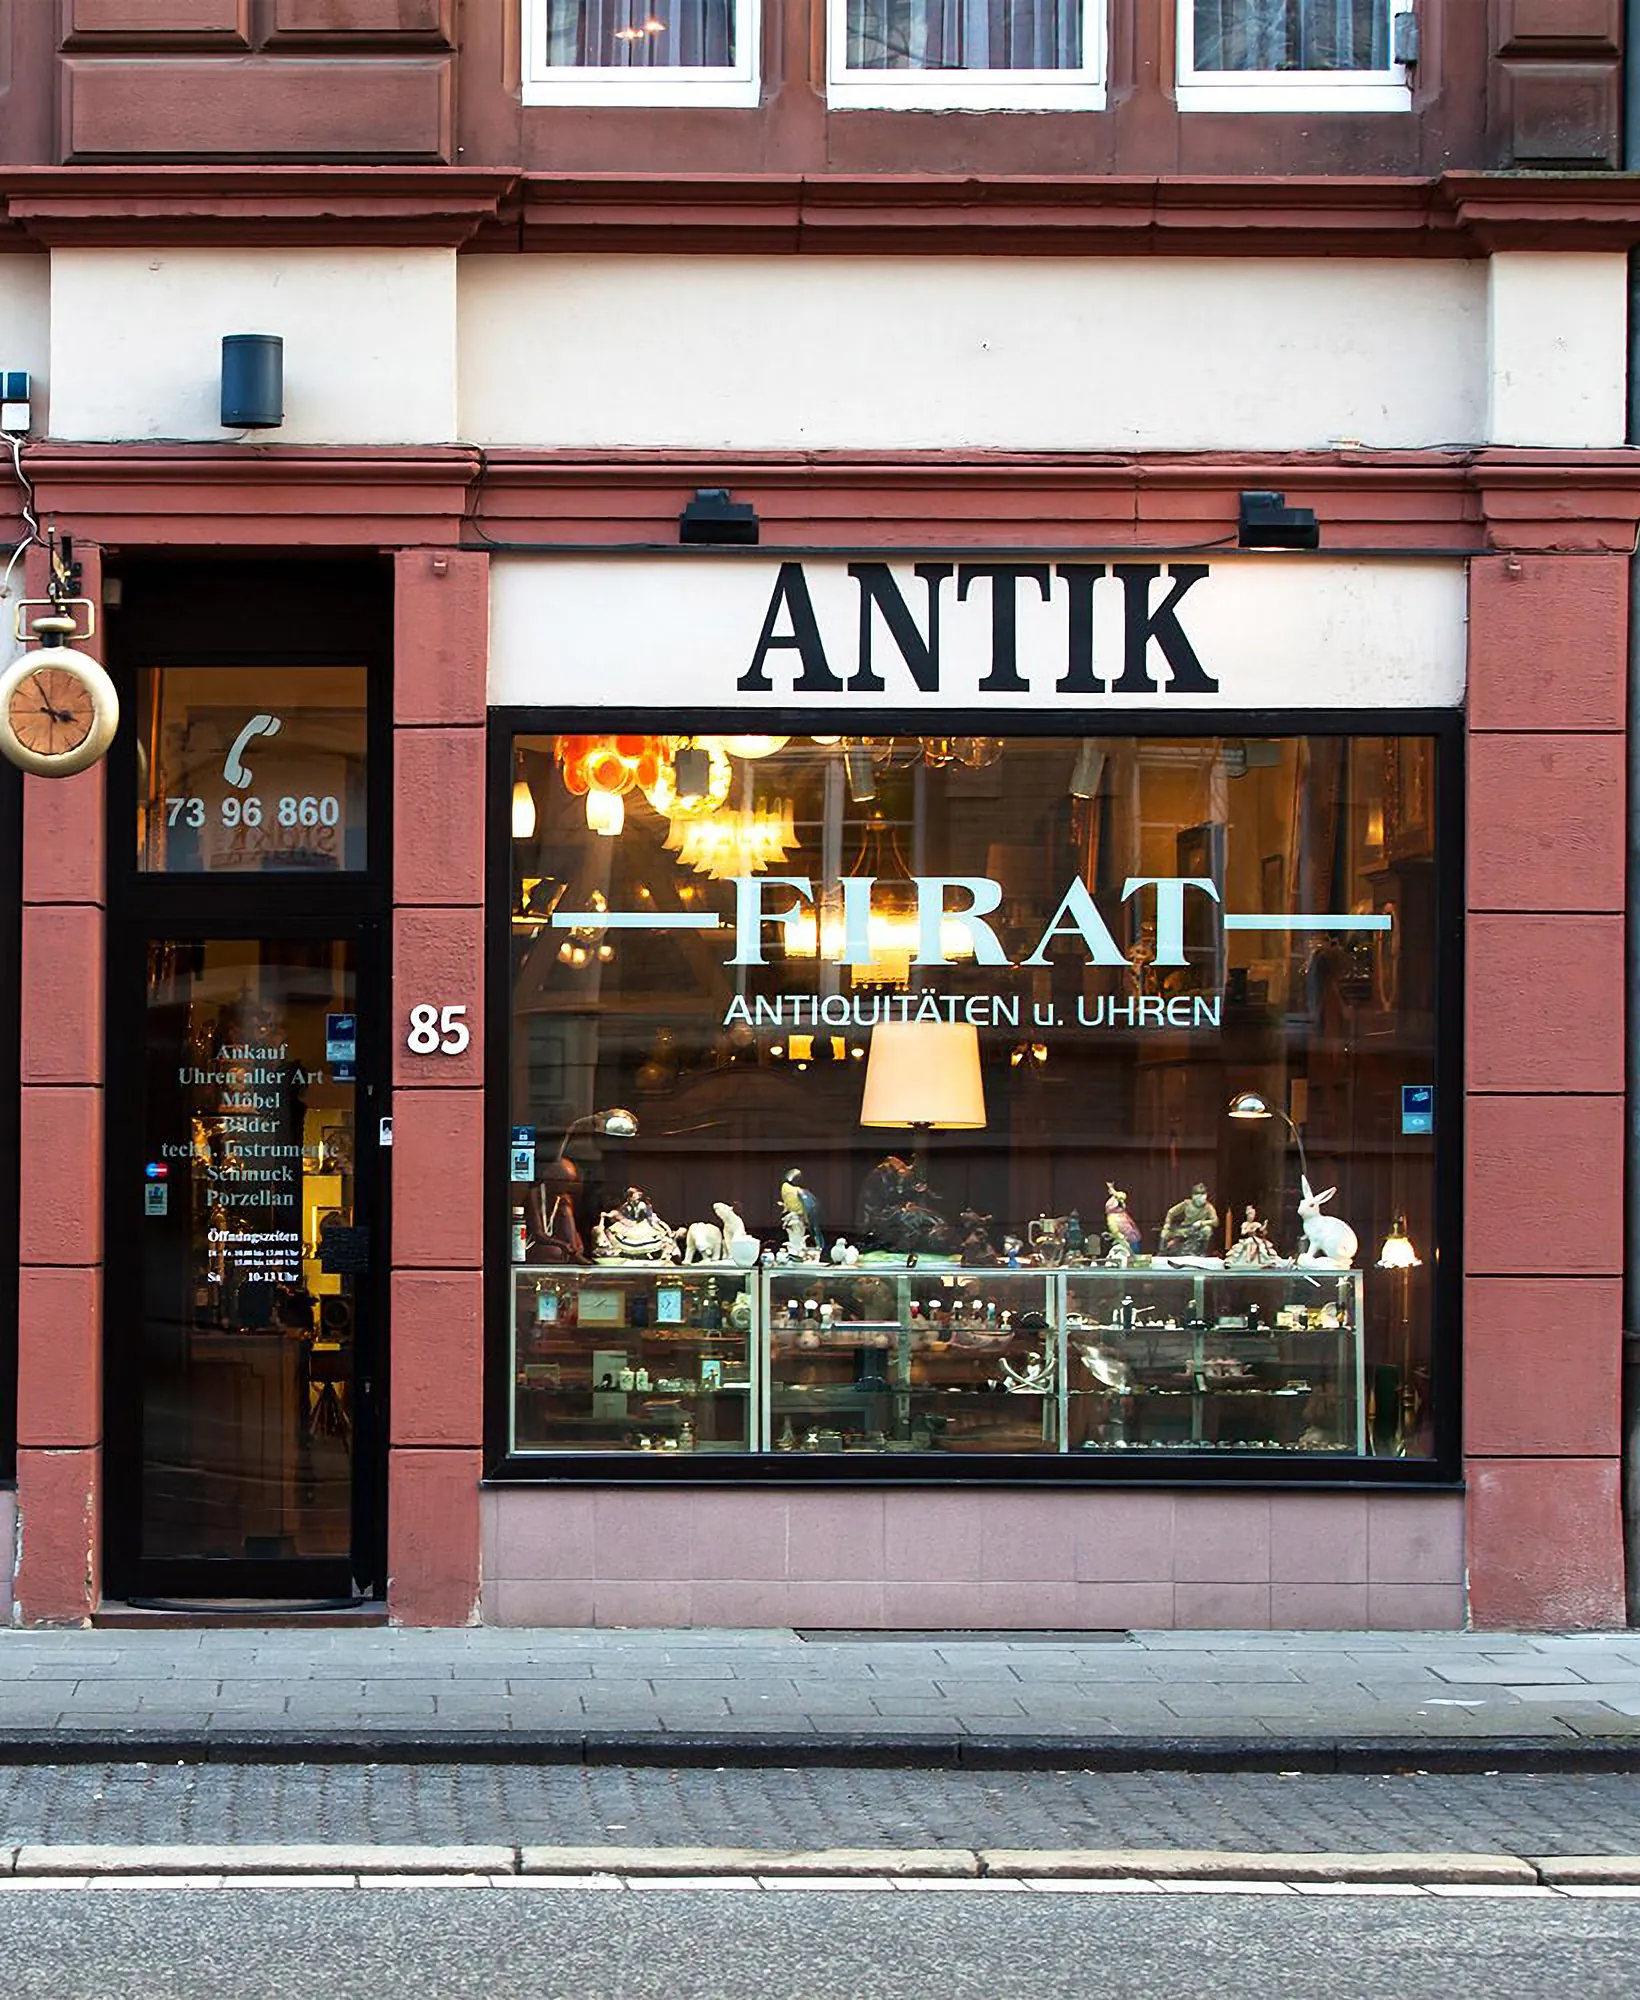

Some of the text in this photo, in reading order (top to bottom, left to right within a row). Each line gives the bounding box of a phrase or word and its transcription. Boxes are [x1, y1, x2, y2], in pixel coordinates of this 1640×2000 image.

[737, 562, 1219, 693] ANTIK
[165, 796, 340, 827] 73 96 860
[723, 876, 1221, 966] FIRAT
[723, 988, 1221, 1027] ANTIQUITÄTEN u. UHREN
[407, 1003, 470, 1055] 85
[217, 1043, 287, 1060] Ankauf
[178, 1067, 324, 1085] Uhren aller Art
[222, 1091, 280, 1109] Möbel
[222, 1115, 281, 1133] Bilder
[207, 1164, 294, 1182] Schmuck
[206, 1187, 294, 1206] Porzellan
